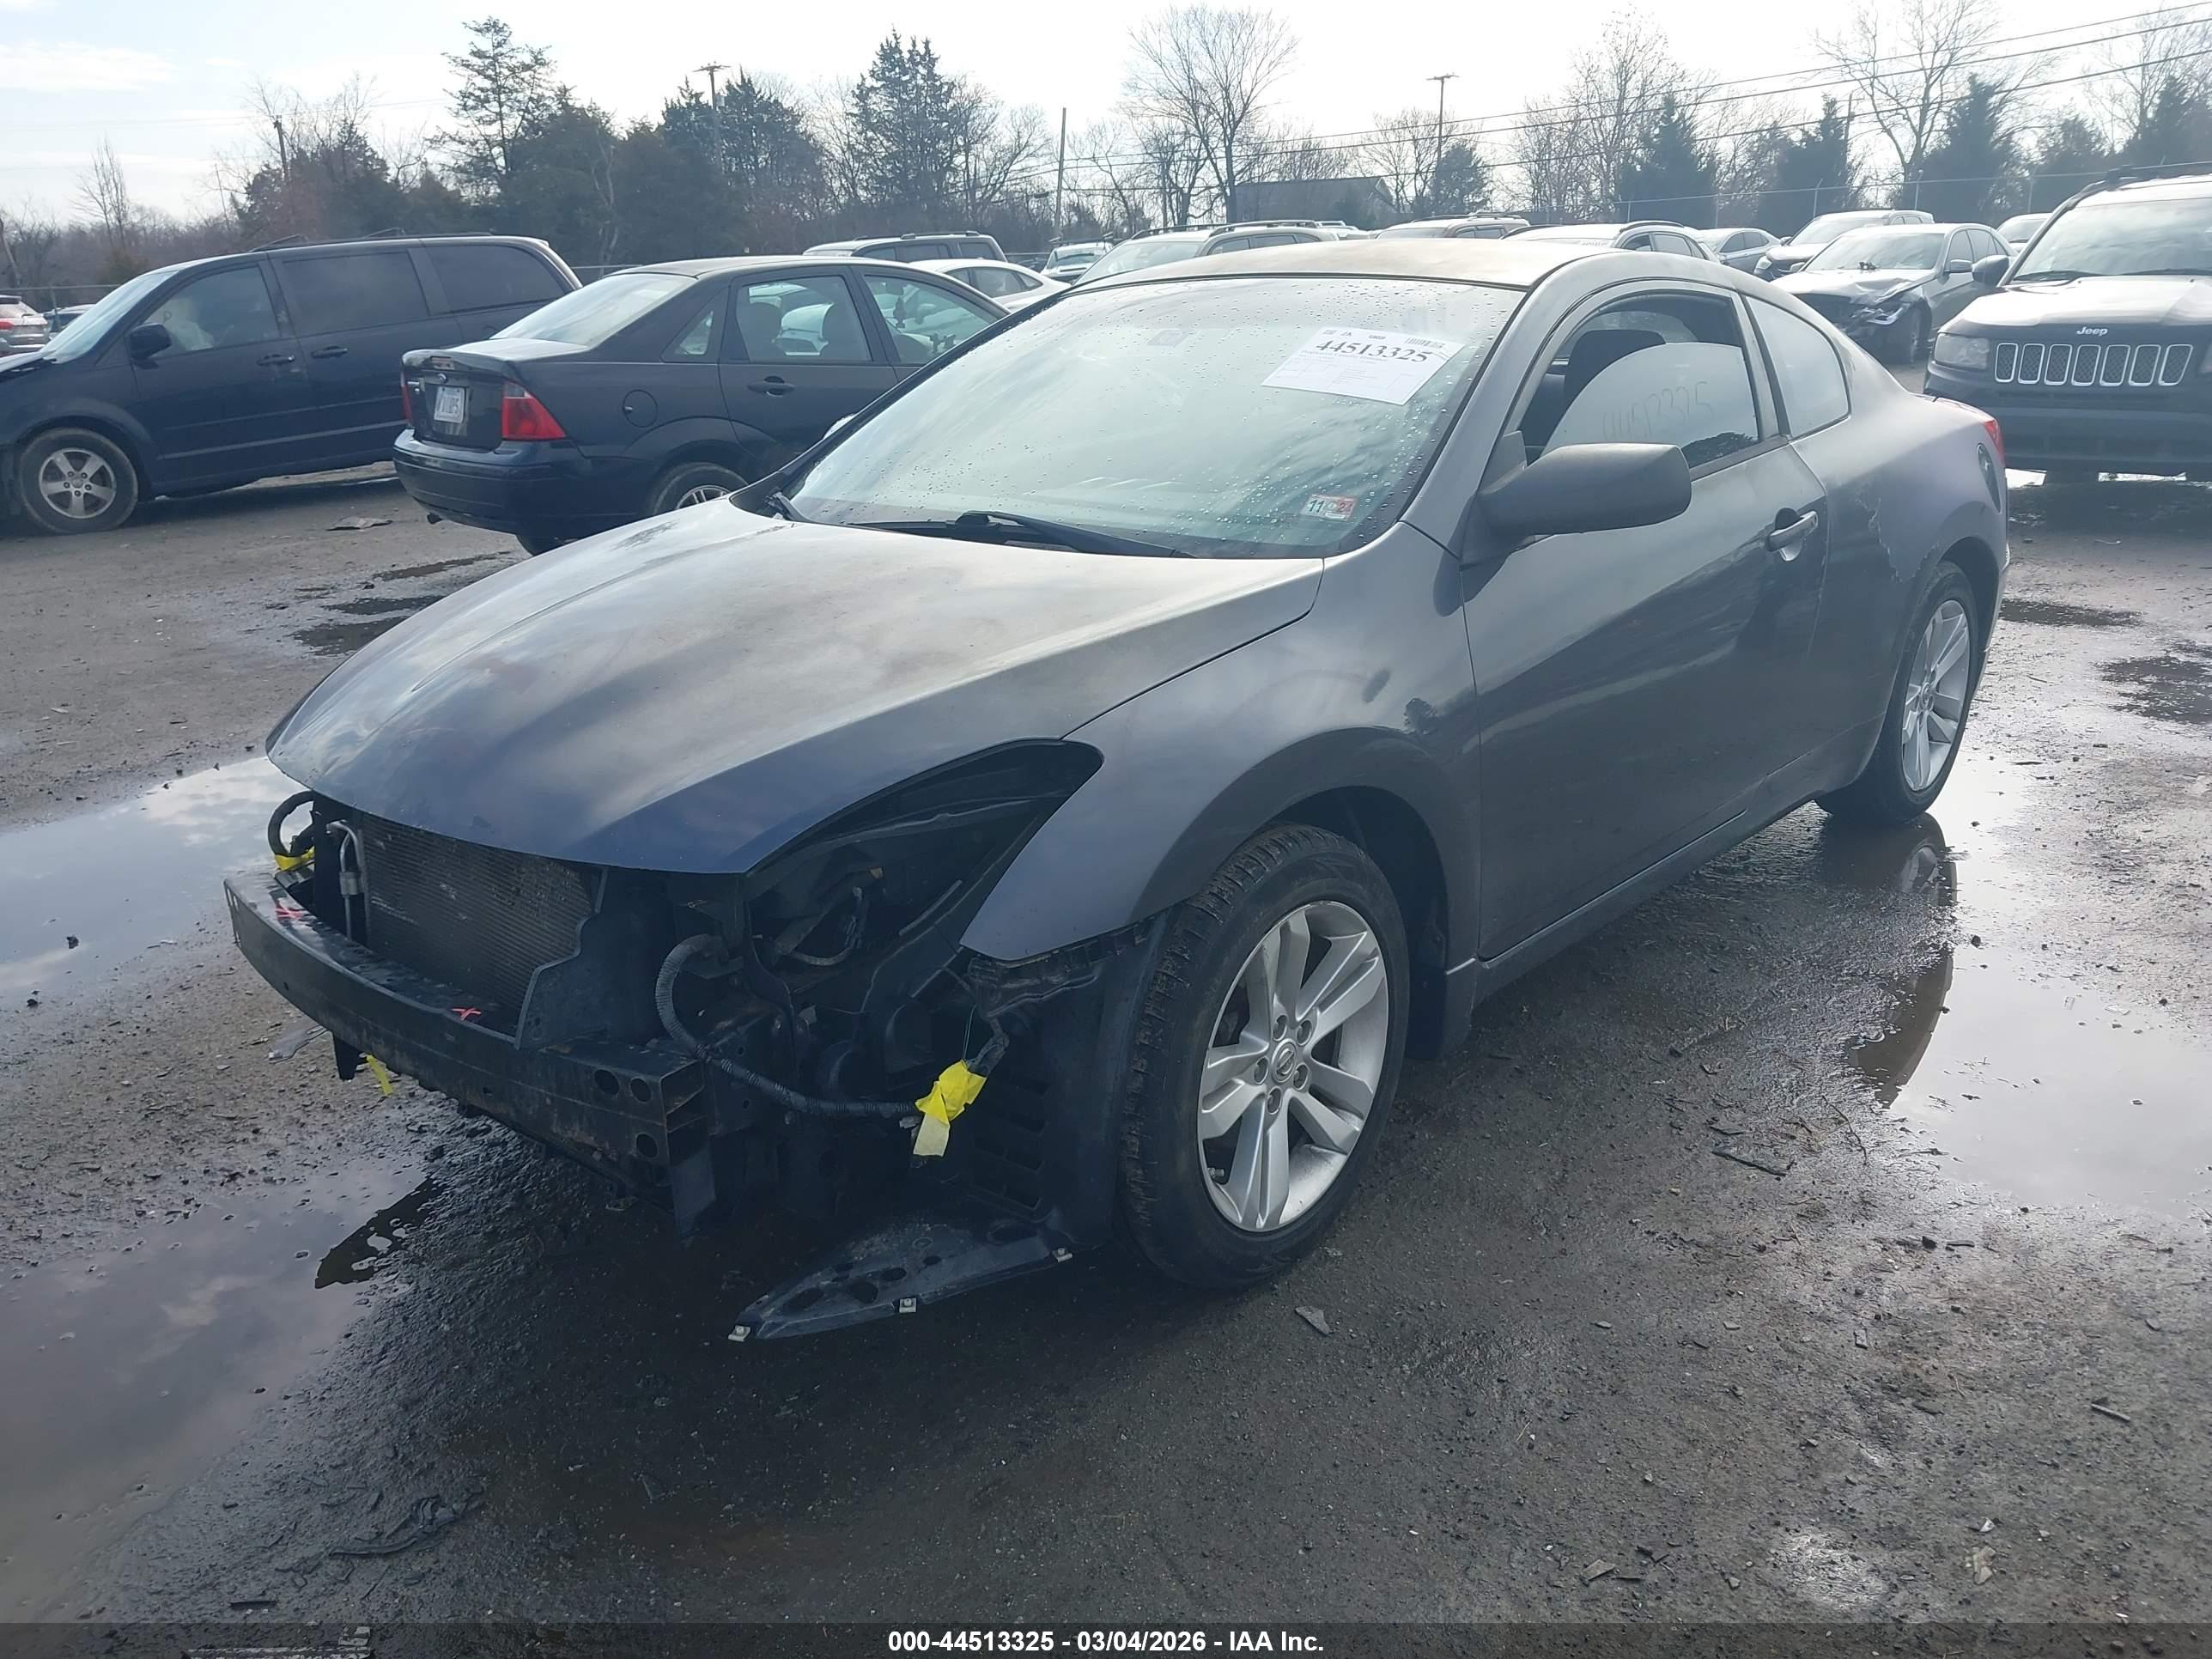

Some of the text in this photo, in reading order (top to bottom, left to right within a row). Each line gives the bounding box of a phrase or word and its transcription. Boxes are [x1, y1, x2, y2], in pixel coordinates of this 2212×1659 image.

[2076, 326, 2108, 336] Jeep
[1316, 339, 1433, 363] 44513325
[1308, 498, 1326, 514] 11
